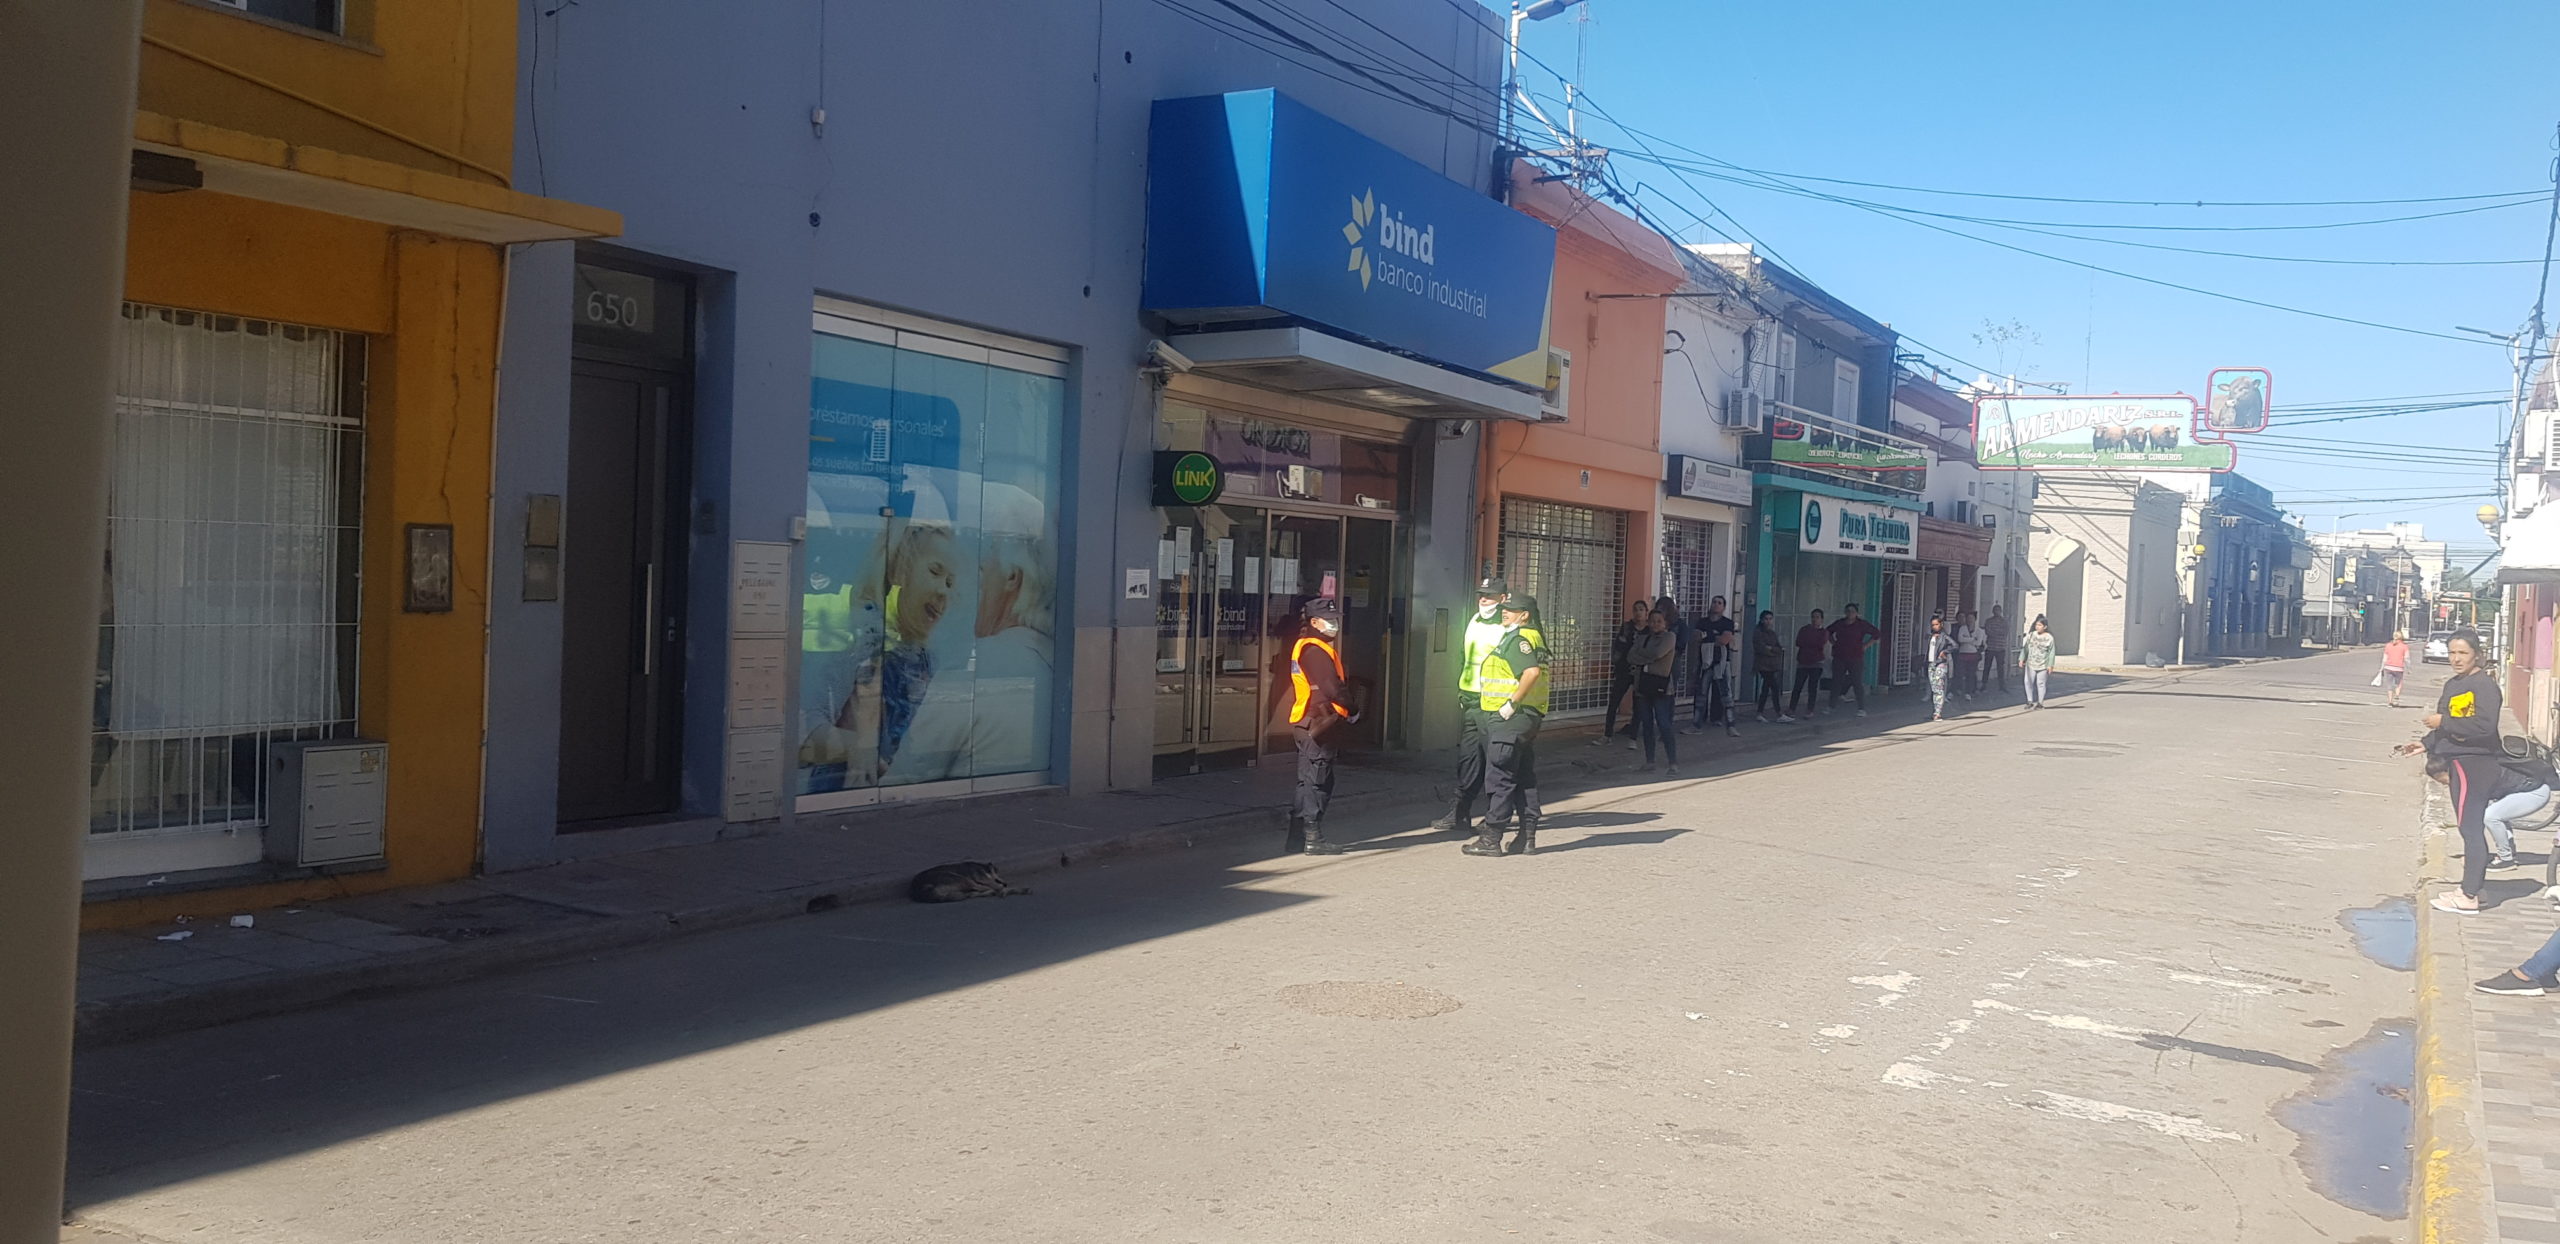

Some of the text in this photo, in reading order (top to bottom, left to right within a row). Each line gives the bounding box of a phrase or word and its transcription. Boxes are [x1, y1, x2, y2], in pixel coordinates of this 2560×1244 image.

[1380, 203, 1434, 266] bind
[1378, 252, 1487, 319] banco industrial
[587, 291, 638, 327] 650
[1981, 405, 2143, 461] ARMENDARIZ
[1176, 466, 1215, 487] LINK
[1839, 508, 1910, 546] PURA TERNURA
[1223, 606, 1246, 621] bind
